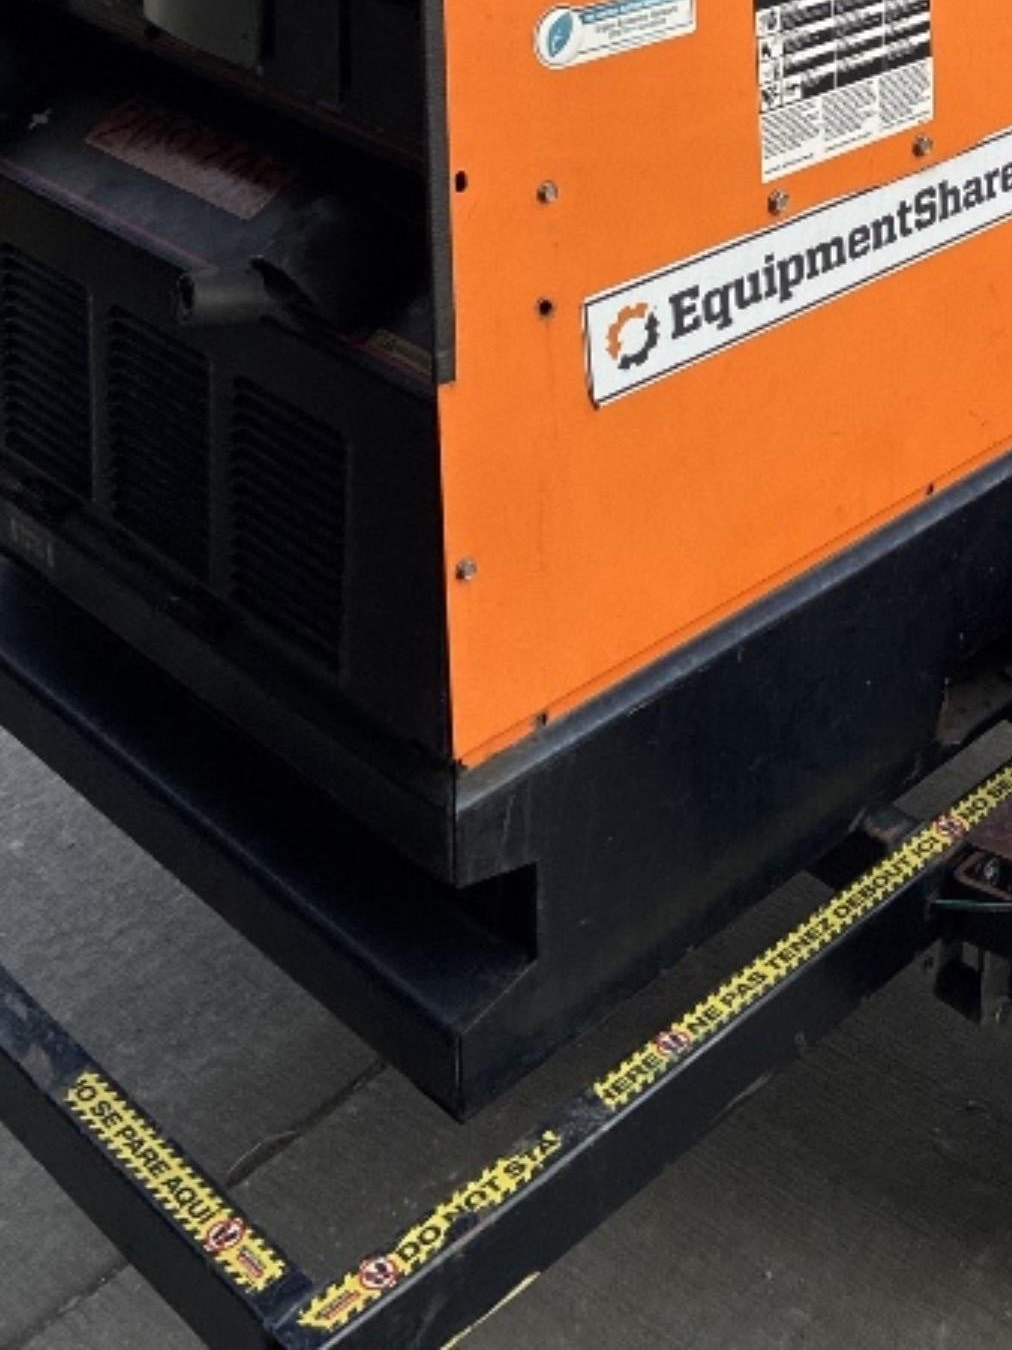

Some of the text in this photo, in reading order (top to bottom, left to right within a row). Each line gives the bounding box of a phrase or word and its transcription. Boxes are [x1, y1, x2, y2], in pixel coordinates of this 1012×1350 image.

[687, 1003, 724, 1031] NE
[719, 970, 768, 1008] PAS
[766, 916, 830, 970] TENEZ
[833, 854, 911, 920] DEBOUT
[90, 1100, 123, 1128] SE
[113, 1125, 172, 1179] PARE
[397, 1225, 442, 1262] DO
